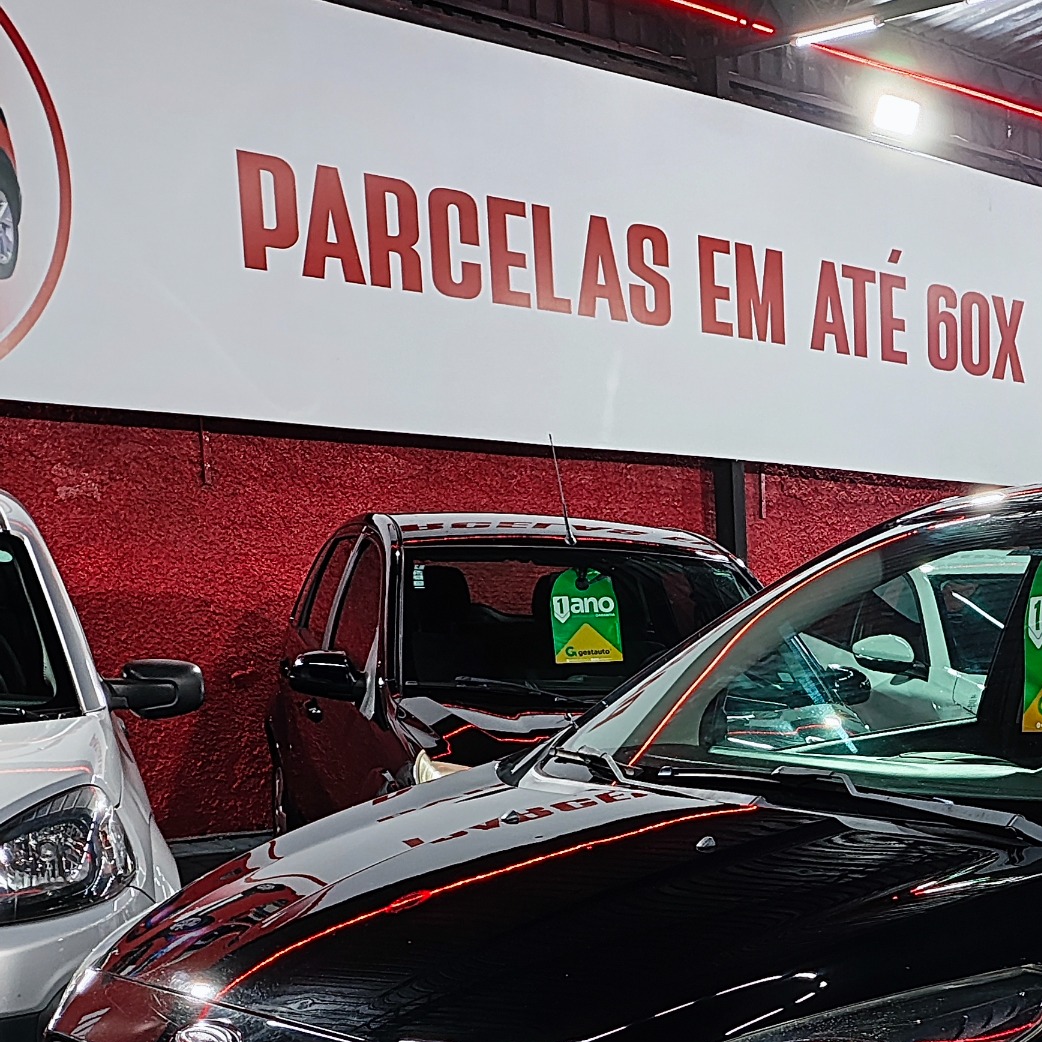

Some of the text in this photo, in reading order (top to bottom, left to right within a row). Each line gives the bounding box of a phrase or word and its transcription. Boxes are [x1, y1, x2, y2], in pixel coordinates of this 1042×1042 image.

[235, 148, 1026, 384] PARCELAS EM ATÉ 60X
